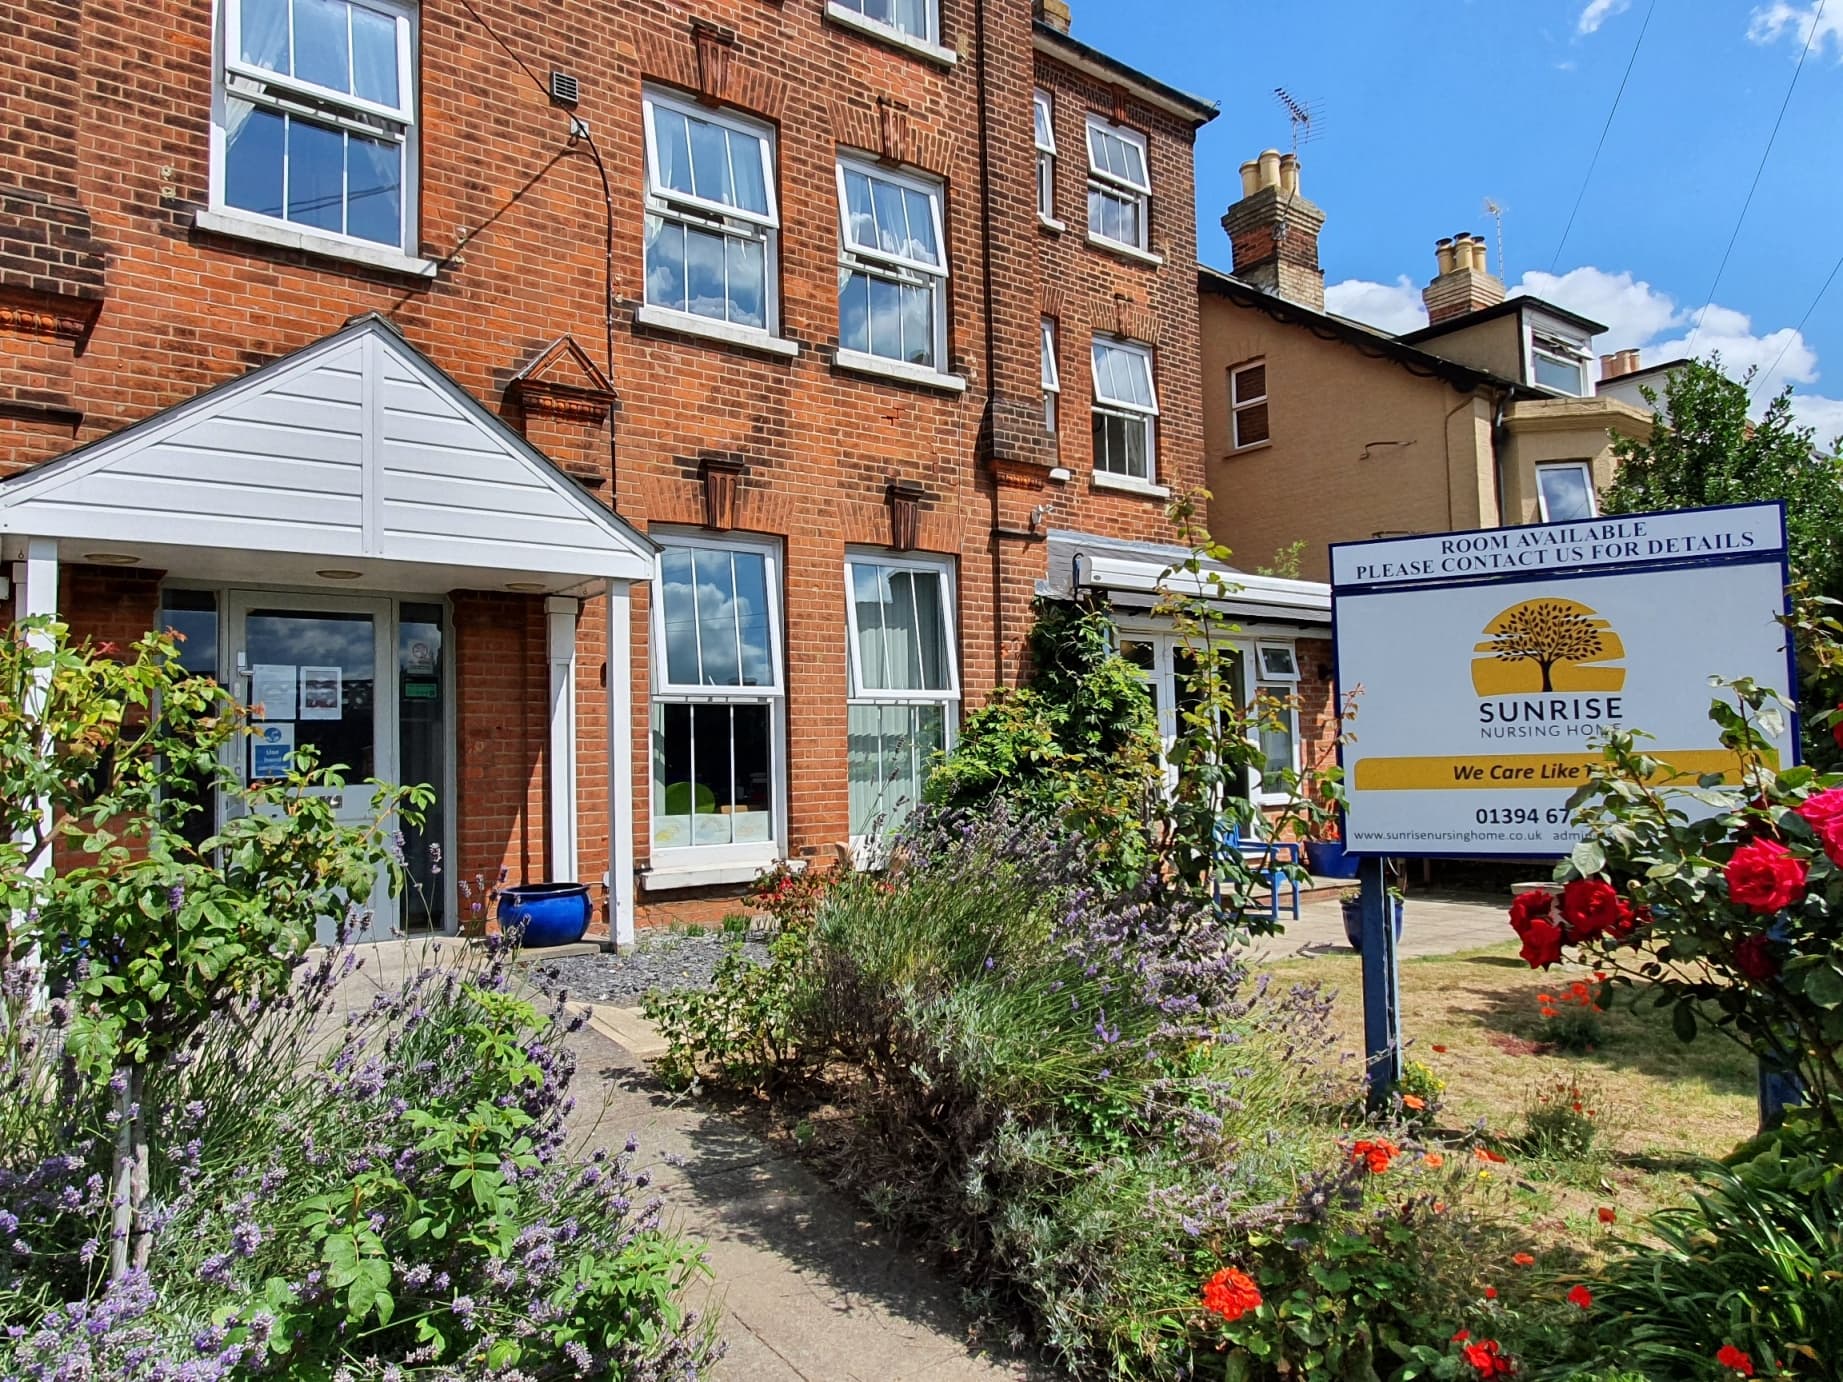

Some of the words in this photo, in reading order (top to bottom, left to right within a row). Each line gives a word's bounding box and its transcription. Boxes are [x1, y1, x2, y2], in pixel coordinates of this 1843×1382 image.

[1441, 535, 1509, 555] ROOM
[1516, 521, 1647, 548] AVAILABLE
[1356, 563, 1434, 580] PLEASE
[1441, 549, 1548, 572] CONTACT
[1556, 546, 1584, 563] US
[1591, 541, 1640, 560] FOR
[1648, 531, 1755, 555] DETAILS
[1479, 697, 1623, 723] SUNRISE
[1480, 724, 1561, 739] NURSING
[1453, 765, 1484, 781] We
[1489, 764, 1535, 780] Care
[1540, 762, 1580, 780] Like
[1475, 808, 1540, 825] 01394
[1353, 829, 1543, 843] www.sunrisenursinghome.co.uk
